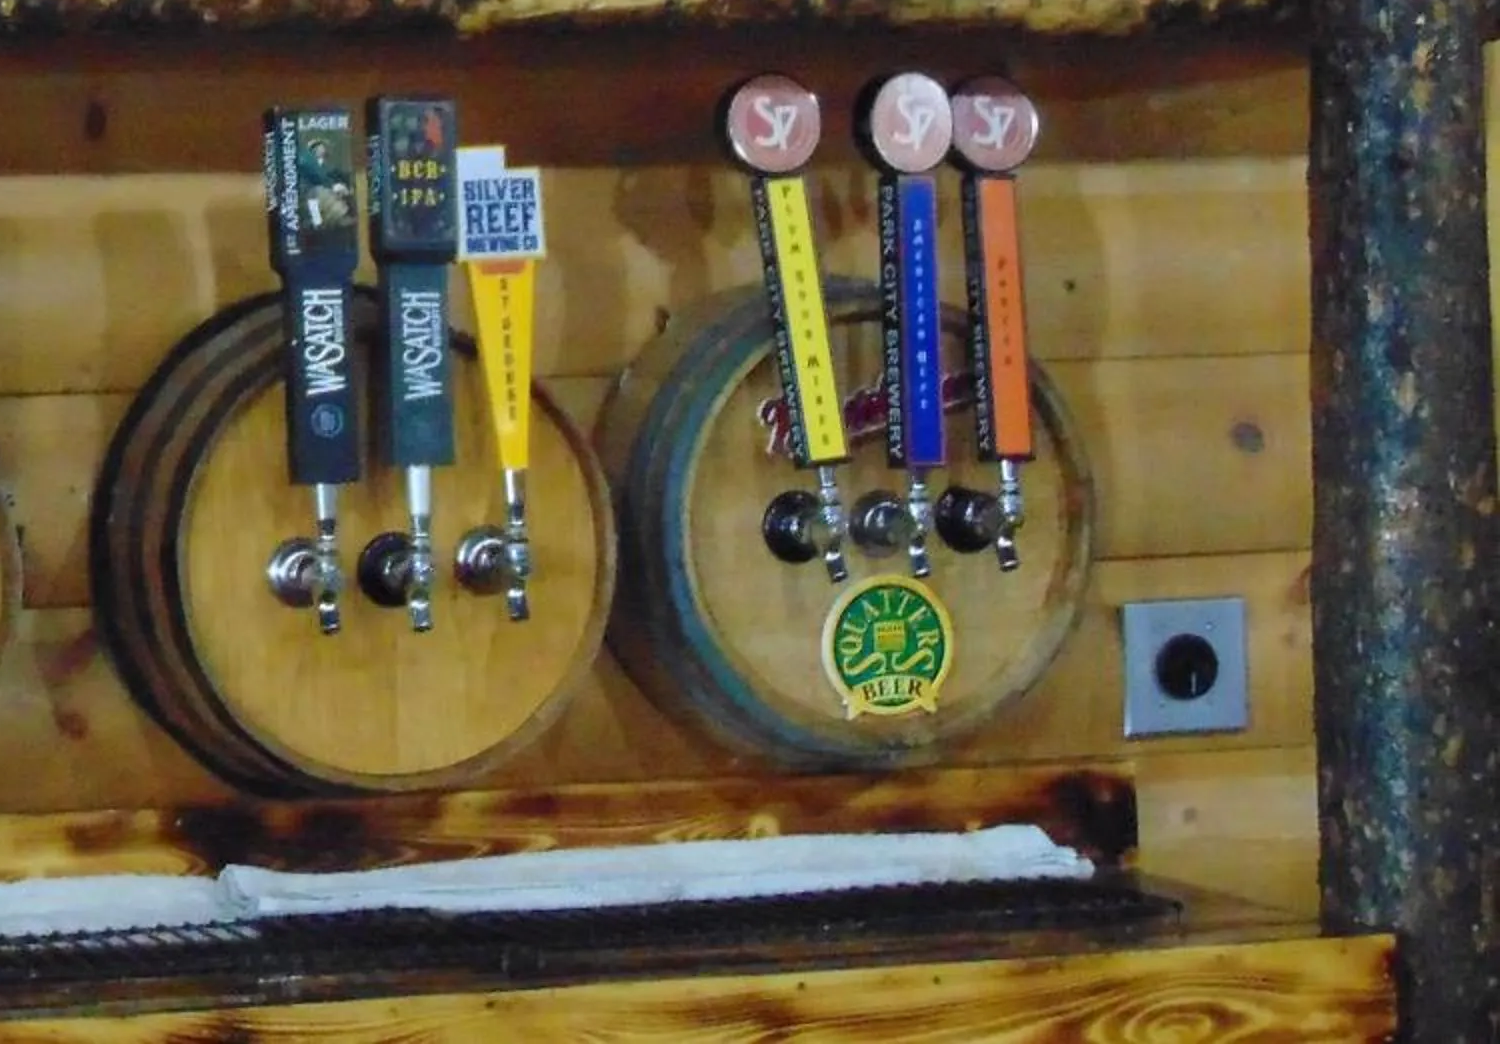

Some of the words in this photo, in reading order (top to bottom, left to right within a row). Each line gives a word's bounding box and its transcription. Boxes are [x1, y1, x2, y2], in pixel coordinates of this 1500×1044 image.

[297, 115, 350, 130] LAGER
[464, 178, 534, 201] SILVER
[466, 202, 536, 235] REEF
[882, 185, 896, 256] PARK
[884, 263, 898, 323] CITY
[302, 289, 346, 396] WASATCH
[402, 292, 442, 401] WASATCH
[886, 329, 903, 459] BREWERY
[839, 587, 939, 675] SQUATTERS
[861, 677, 922, 701] BEER
